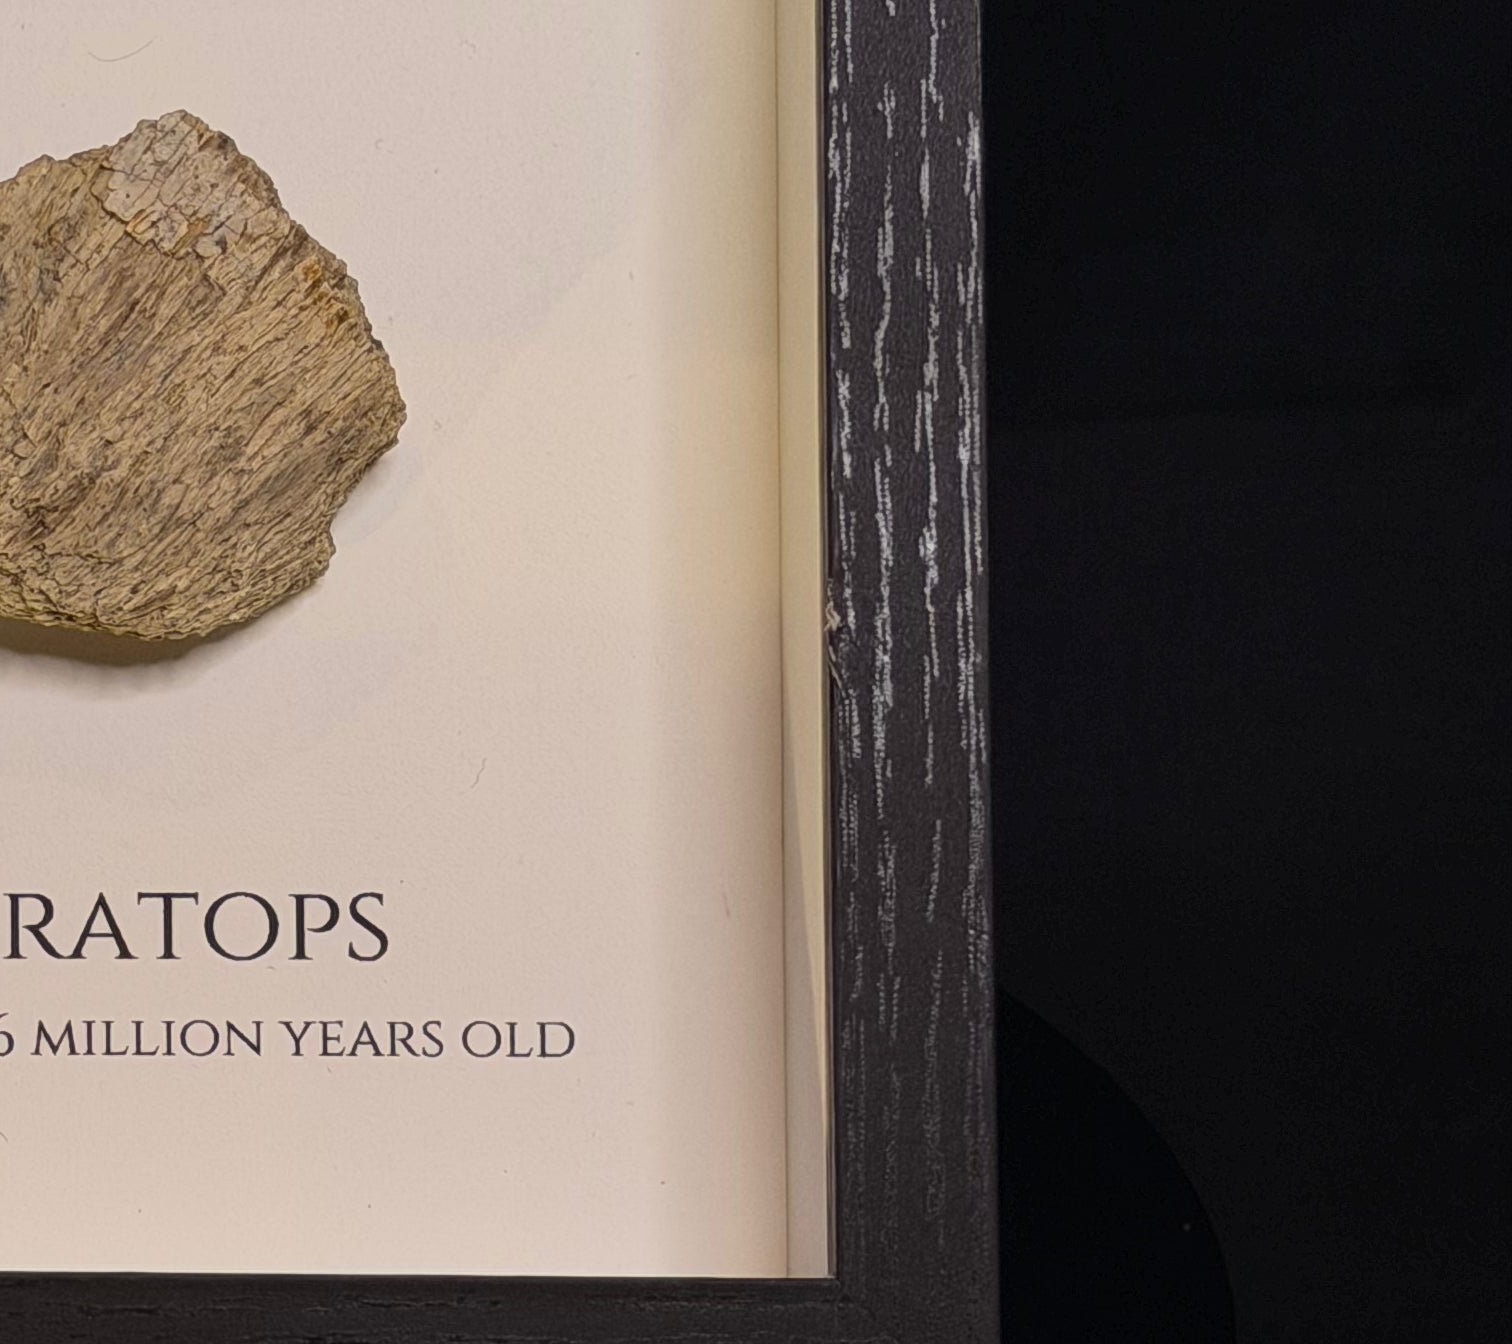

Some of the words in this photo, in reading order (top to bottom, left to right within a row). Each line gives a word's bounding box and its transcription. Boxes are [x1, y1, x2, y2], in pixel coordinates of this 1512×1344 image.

[30, 1018, 265, 1057] MILLION
[276, 1019, 444, 1058] YEARS
[460, 1020, 576, 1059] OLD
